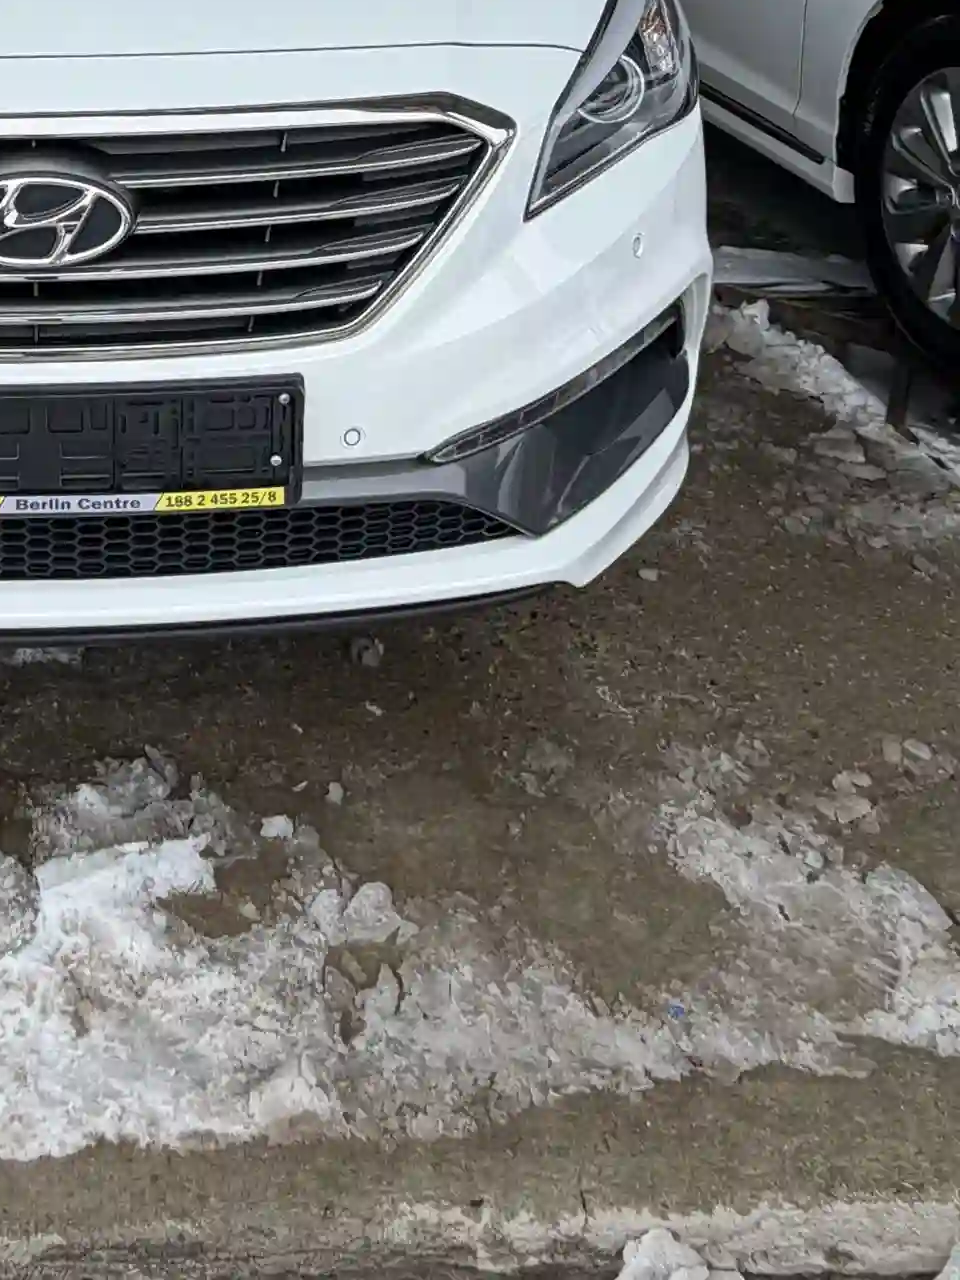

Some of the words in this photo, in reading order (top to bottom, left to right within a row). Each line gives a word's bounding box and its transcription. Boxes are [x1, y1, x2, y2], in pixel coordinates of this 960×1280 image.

[15, 498, 71, 511] Berlin
[78, 497, 141, 510] Centre
[197, 494, 206, 506] 2
[241, 491, 277, 504] 25/8
